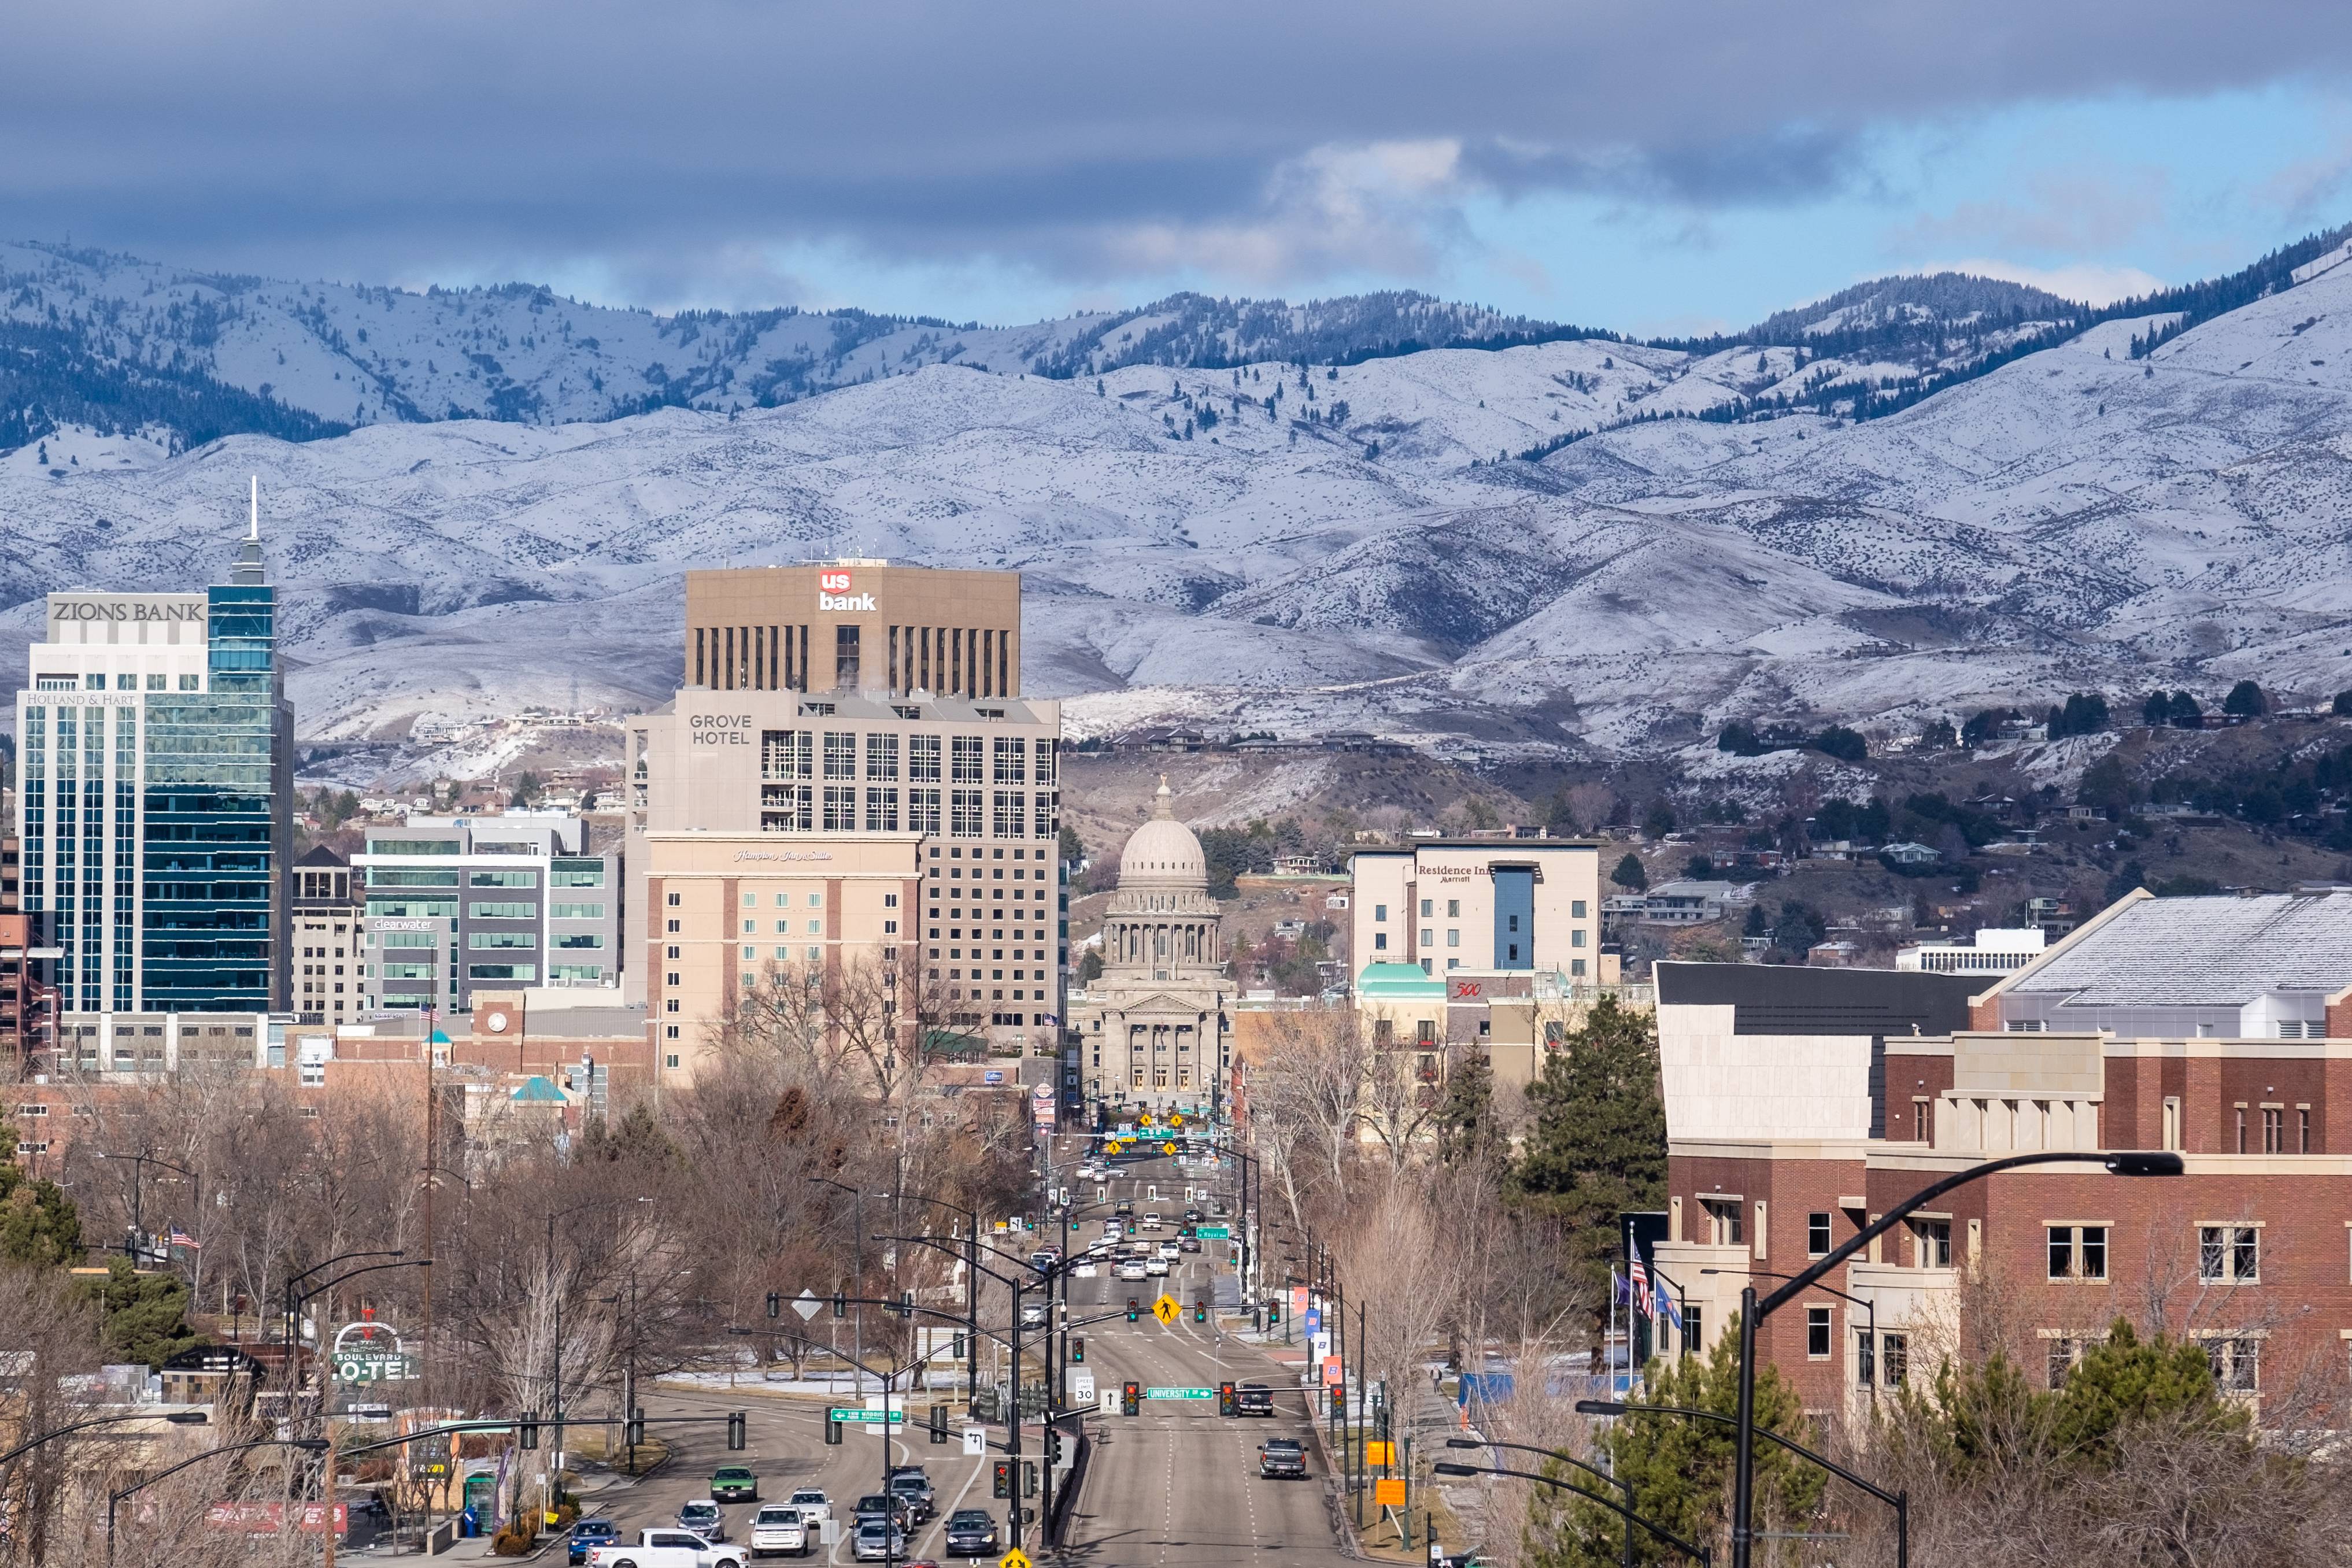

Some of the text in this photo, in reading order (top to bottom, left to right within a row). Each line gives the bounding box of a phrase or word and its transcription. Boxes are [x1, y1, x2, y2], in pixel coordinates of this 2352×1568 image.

[819, 592, 877, 611] bank
[53, 603, 205, 621] ZIONS BANK
[27, 694, 135, 705] HOLLAND & HART
[690, 715, 752, 728] GROVE
[693, 731, 749, 744] HOTEL
[732, 850, 779, 862] Hampton
[808, 850, 833, 861] Suites
[1419, 866, 1471, 875] Residence
[374, 919, 432, 930] clearwater
[1452, 982, 1481, 999] 500
[332, 1361, 420, 1381] O-TEL
[1328, 1366, 1338, 1375] B
[1078, 1391, 1092, 1399] 30
[1150, 1389, 1190, 1399] UNIVERSITY
[861, 1411, 891, 1421] MORRISO
